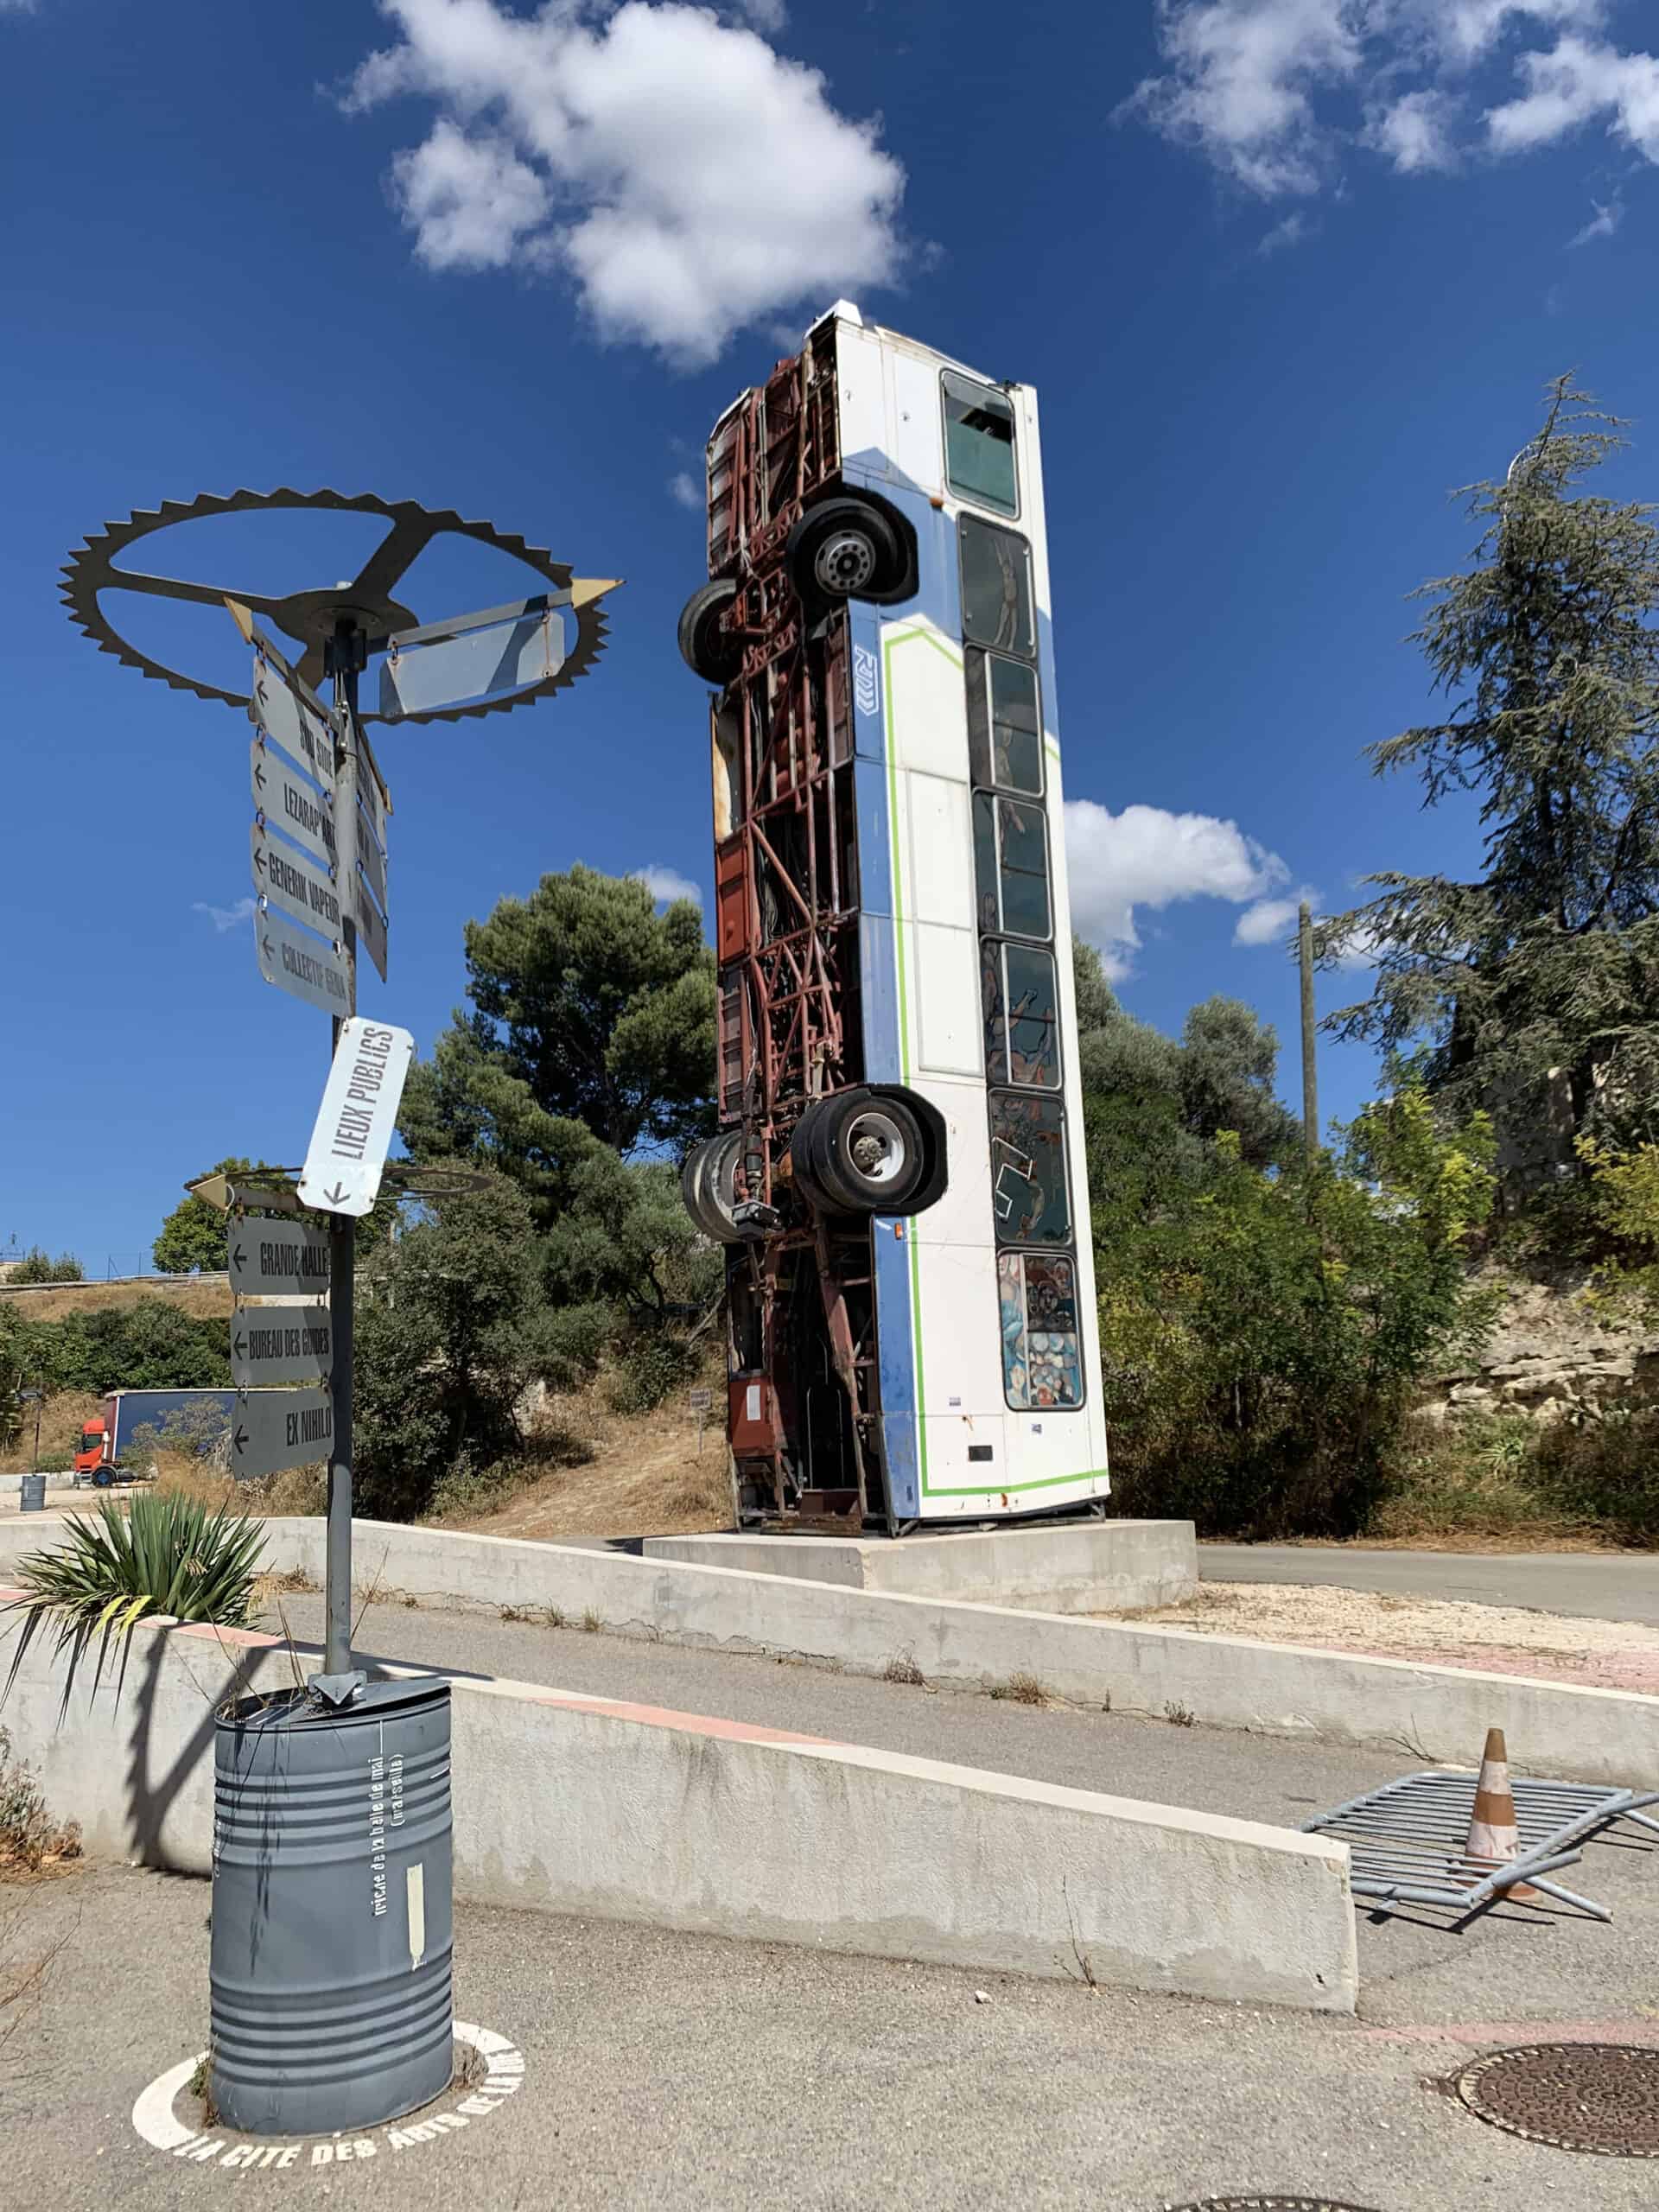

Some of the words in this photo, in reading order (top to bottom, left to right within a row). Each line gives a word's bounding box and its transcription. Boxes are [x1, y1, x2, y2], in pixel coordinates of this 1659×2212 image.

[269, 852, 308, 906] GENERIK
[308, 880, 340, 927] VAPEUR
[346, 1027, 393, 1104] PUBLICS
[331, 1104, 374, 1160] LIEUX
[260, 1242, 300, 1277] GRANDE
[301, 1243, 327, 1277] HALLE
[249, 1329, 283, 1360] BUREAU
[284, 1328, 300, 1357] DES
[286, 1412, 298, 1446] EX
[302, 1407, 332, 1445] NIHILO
[368, 1756, 384, 1781] mai
[368, 1783, 384, 1801] de
[369, 1802, 385, 1836] belle
[371, 1853, 385, 1870] de
[372, 1838, 385, 1852] la
[173, 2136, 226, 2161] LA
[311, 2139, 378, 2166] DES
